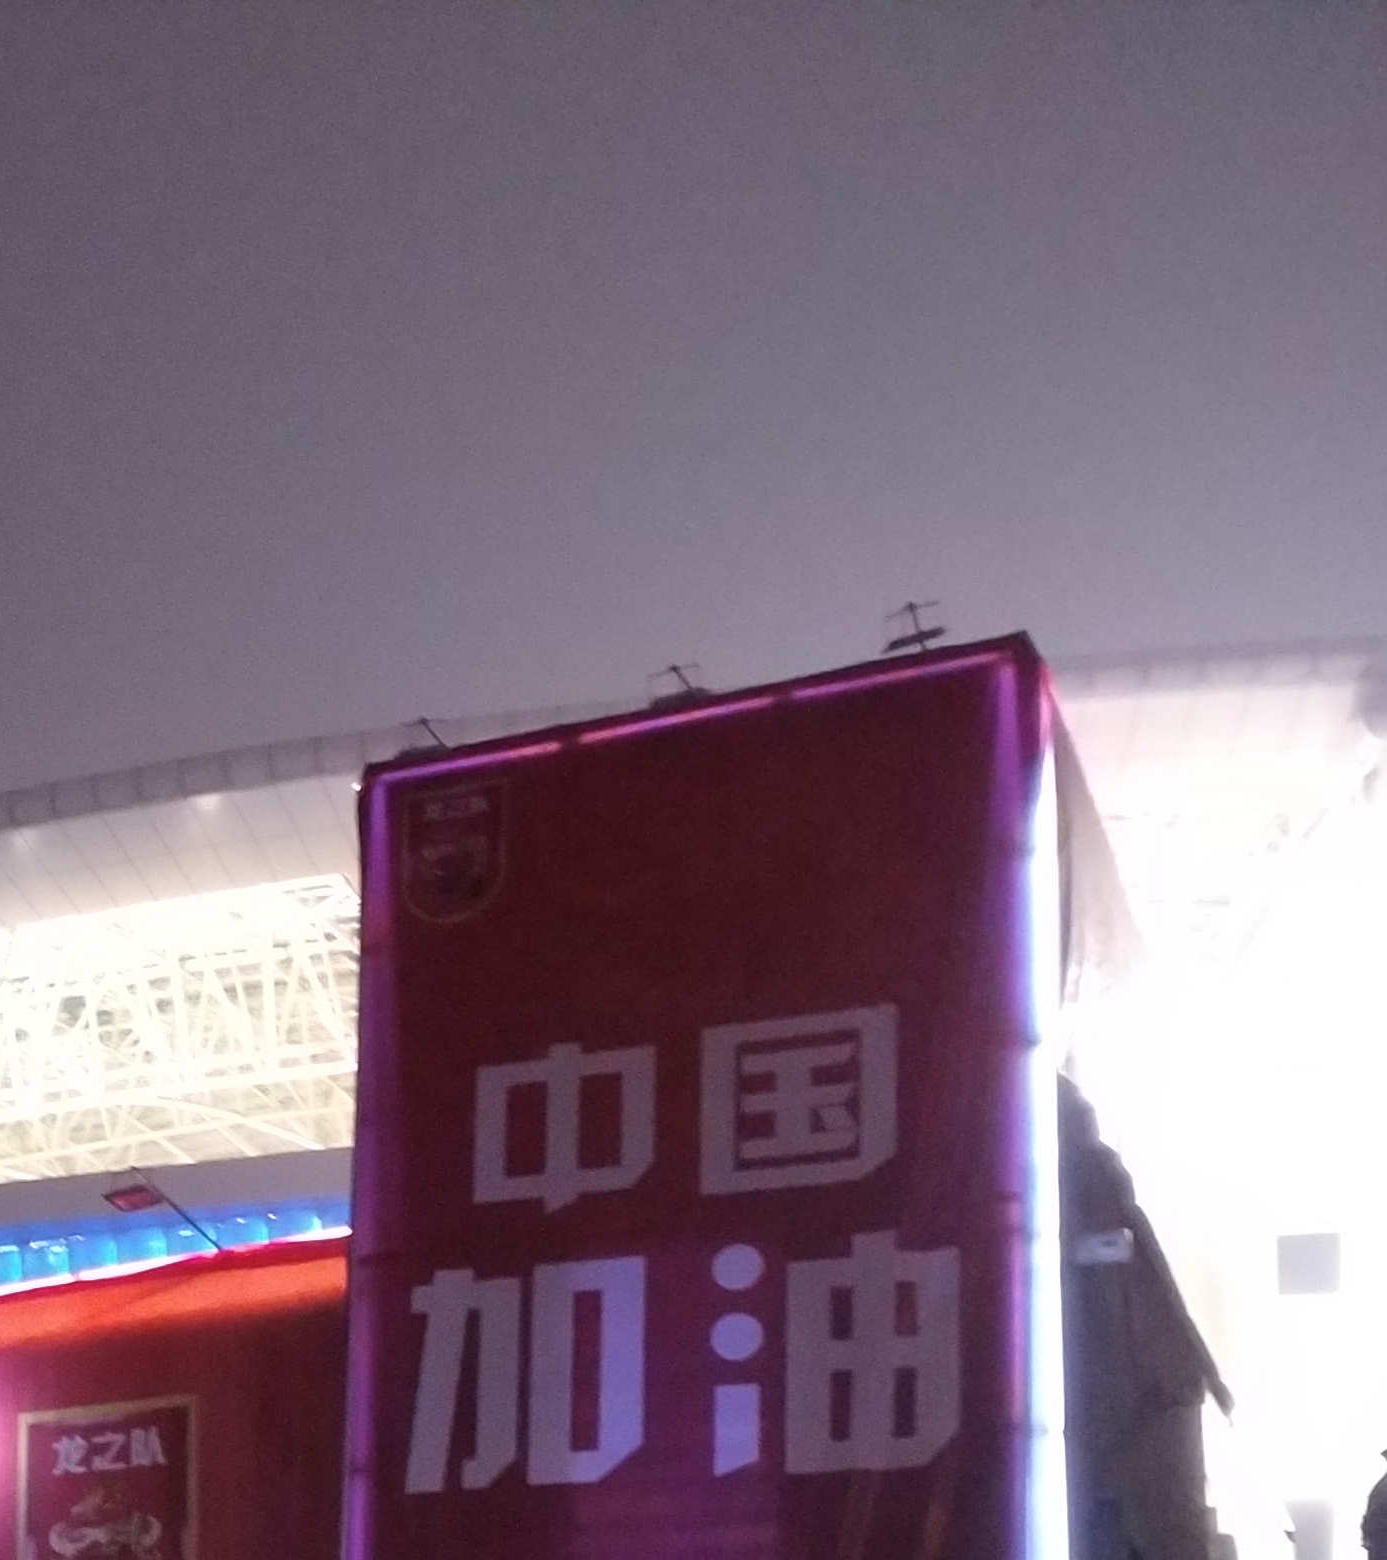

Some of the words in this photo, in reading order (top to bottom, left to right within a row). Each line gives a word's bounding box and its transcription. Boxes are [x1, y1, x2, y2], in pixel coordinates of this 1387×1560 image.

[472, 1003, 899, 1214] 中国
[52, 1425, 168, 1476] 龙之队
[404, 1230, 962, 1495] 加油
